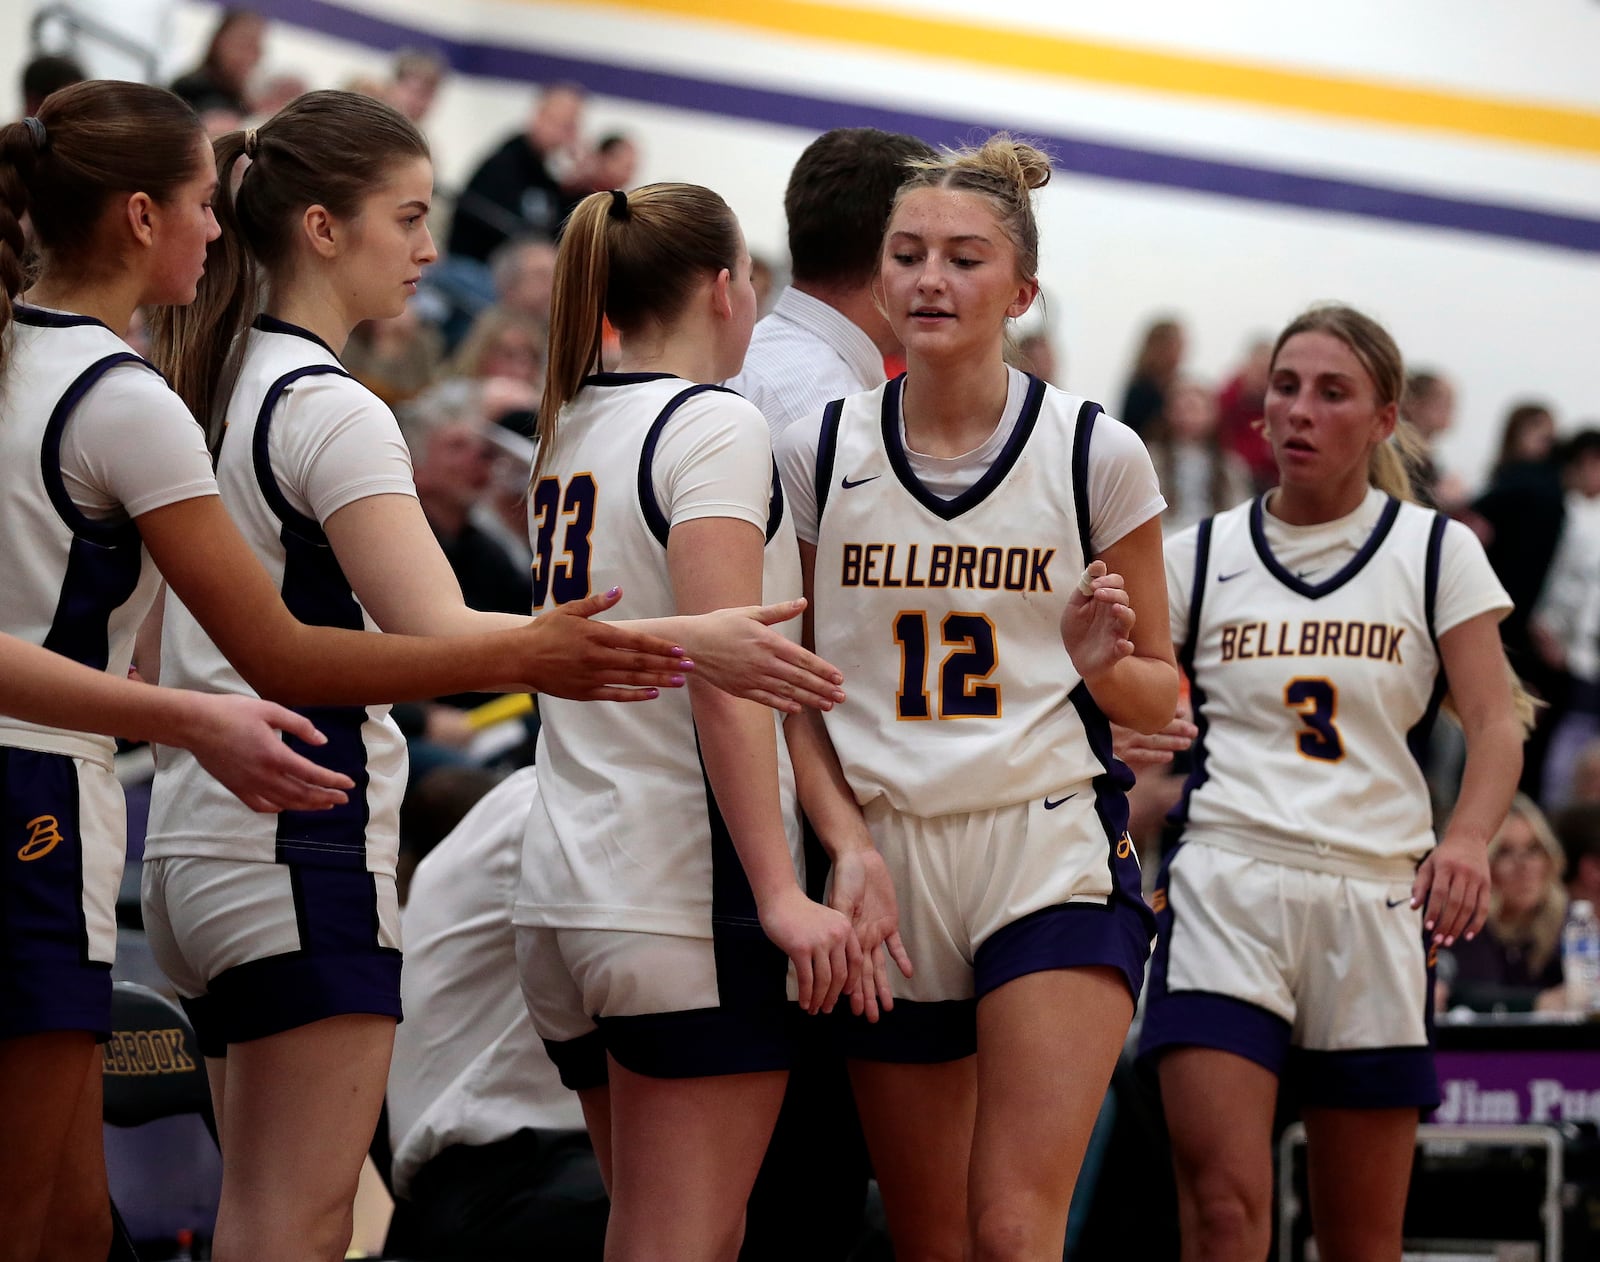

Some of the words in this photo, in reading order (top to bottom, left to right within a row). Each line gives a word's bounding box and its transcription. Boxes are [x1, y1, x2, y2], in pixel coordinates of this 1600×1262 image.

[531, 471, 599, 610] 33
[841, 543, 1057, 593] BELLBROOK
[892, 610, 1002, 721] 12
[1221, 621, 1406, 664] BELLBROOK
[1283, 675, 1347, 764] 3
[17, 814, 64, 861] B
[1435, 1079, 1519, 1124] Jim
